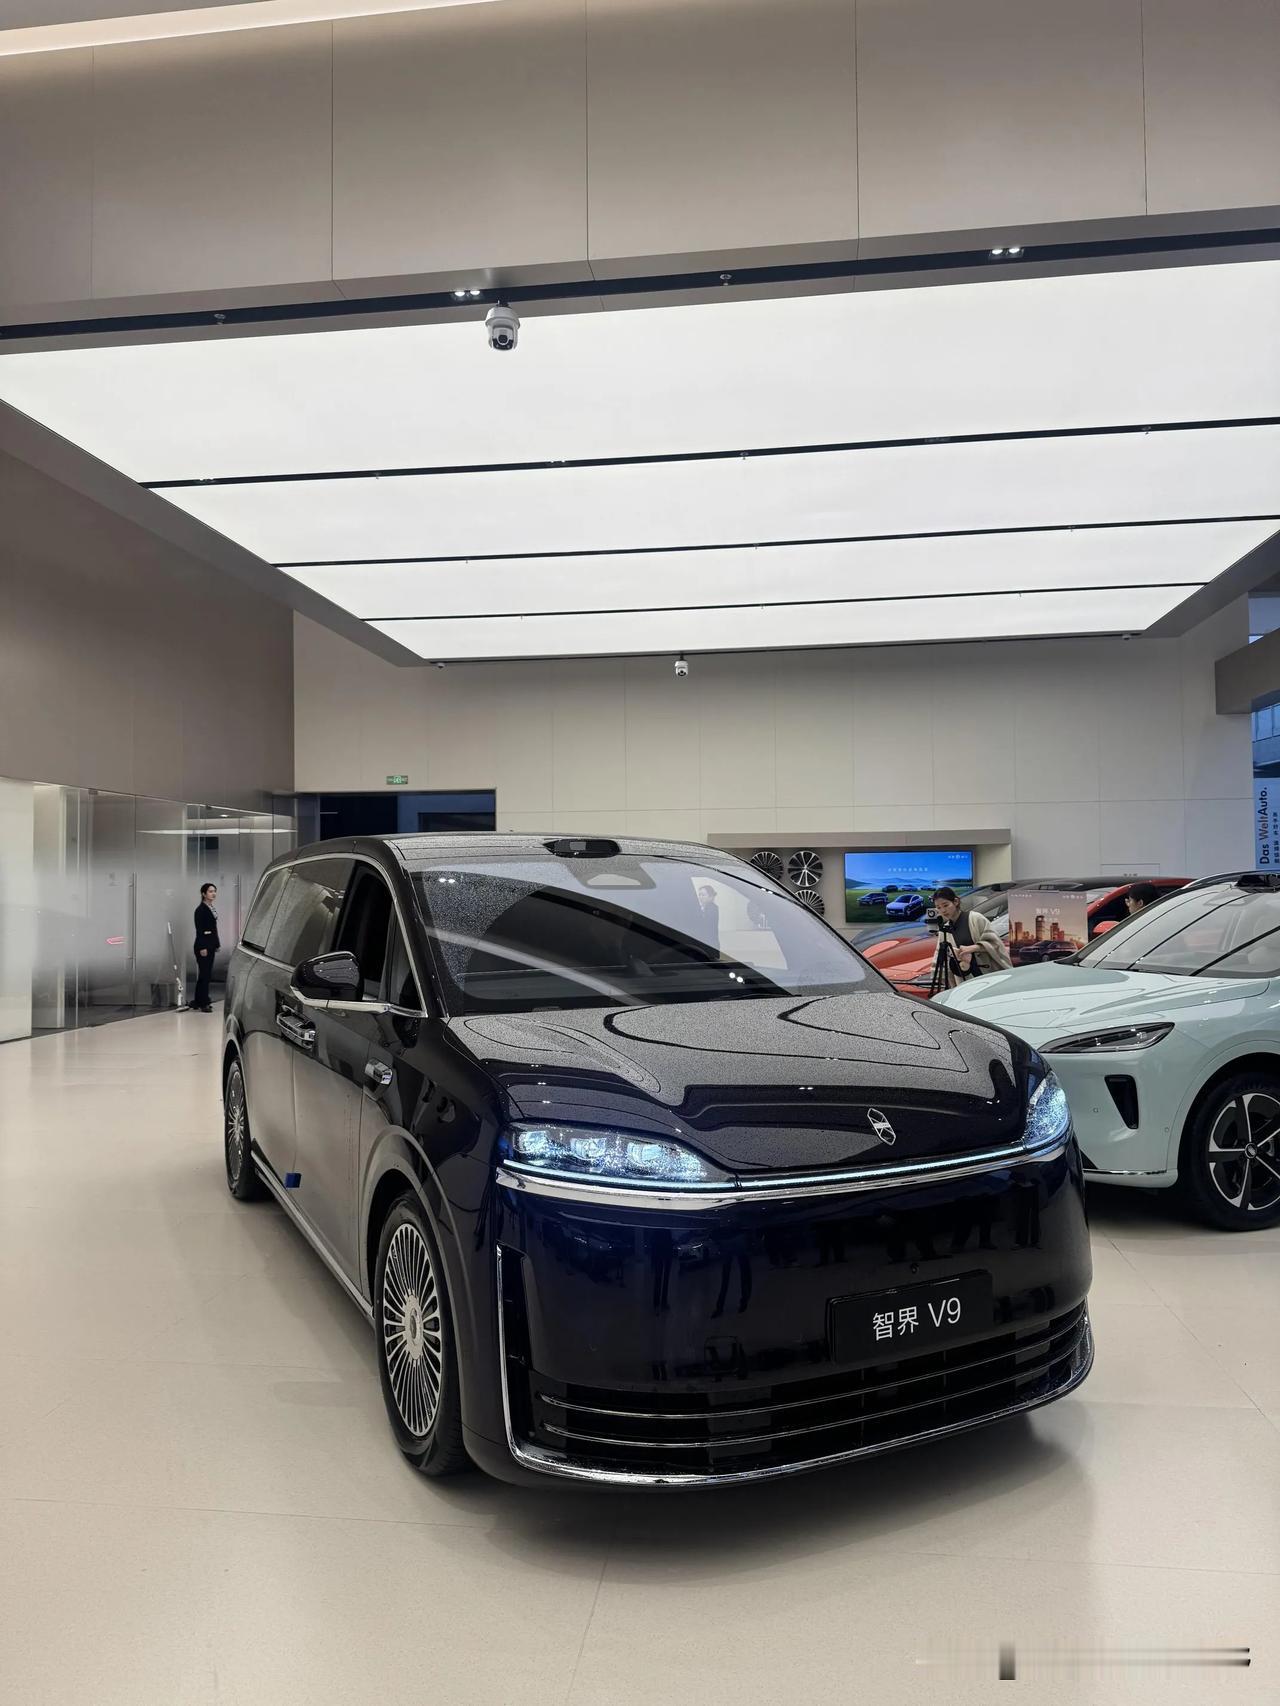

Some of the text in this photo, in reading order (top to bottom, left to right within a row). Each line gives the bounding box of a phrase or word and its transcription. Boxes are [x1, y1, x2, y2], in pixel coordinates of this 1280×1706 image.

[1257, 787, 1270, 864] Das WeltAuto.
[872, 1297, 961, 1341] 智界 V9
